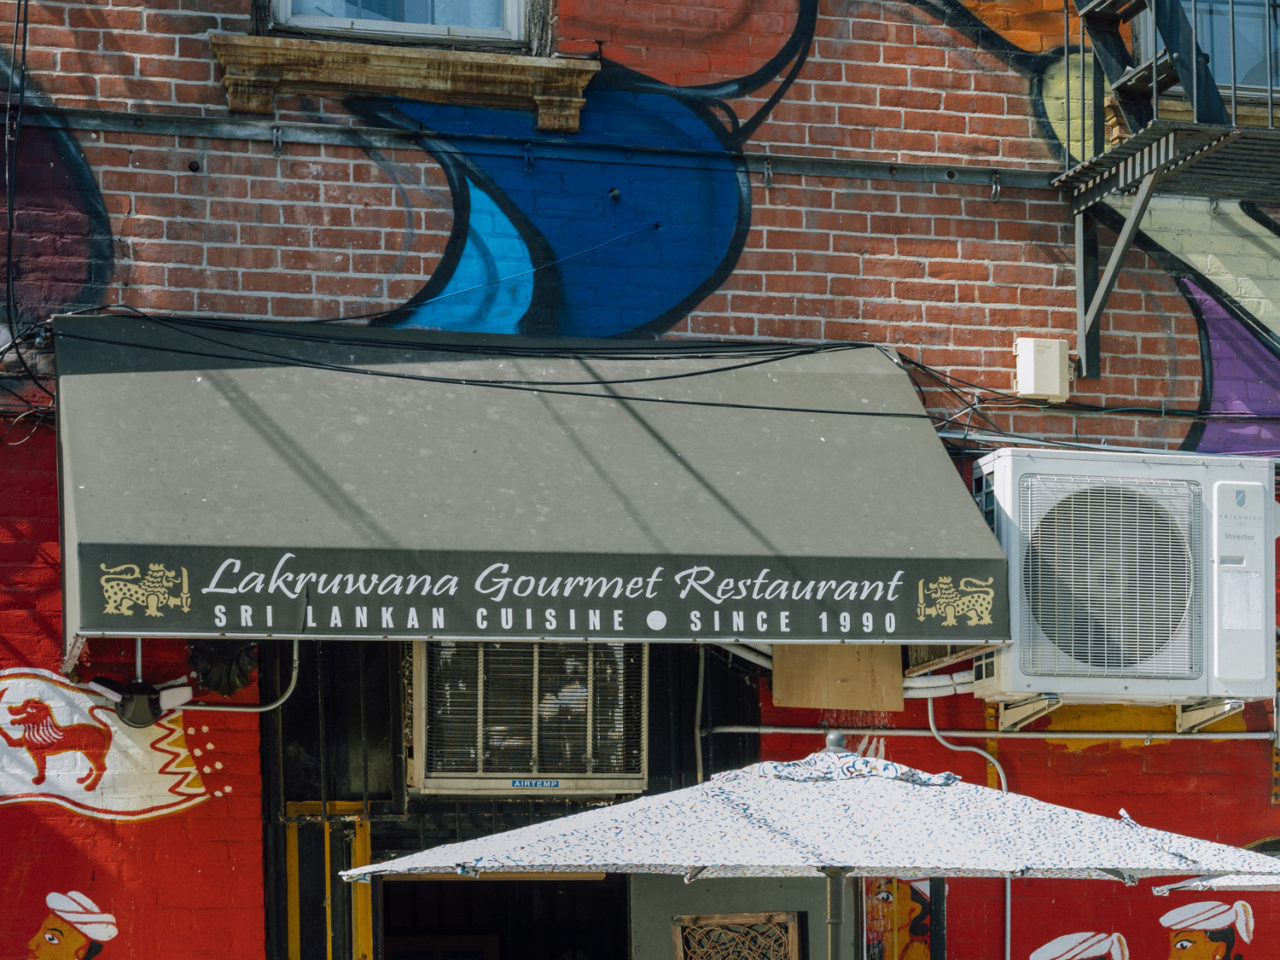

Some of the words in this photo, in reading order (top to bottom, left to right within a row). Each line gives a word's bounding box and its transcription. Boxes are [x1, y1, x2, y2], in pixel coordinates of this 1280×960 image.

[201, 552, 460, 600] Lakruwana
[474, 562, 665, 602] Gourmet
[674, 565, 905, 605] Restaurant
[214, 604, 274, 628] SRI
[306, 604, 446, 630] LANKAN
[475, 607, 625, 632] CUISINE
[689, 609, 792, 633] SINCE
[817, 610, 897, 634] 1990
[513, 780, 558, 788] AIRTEMP
